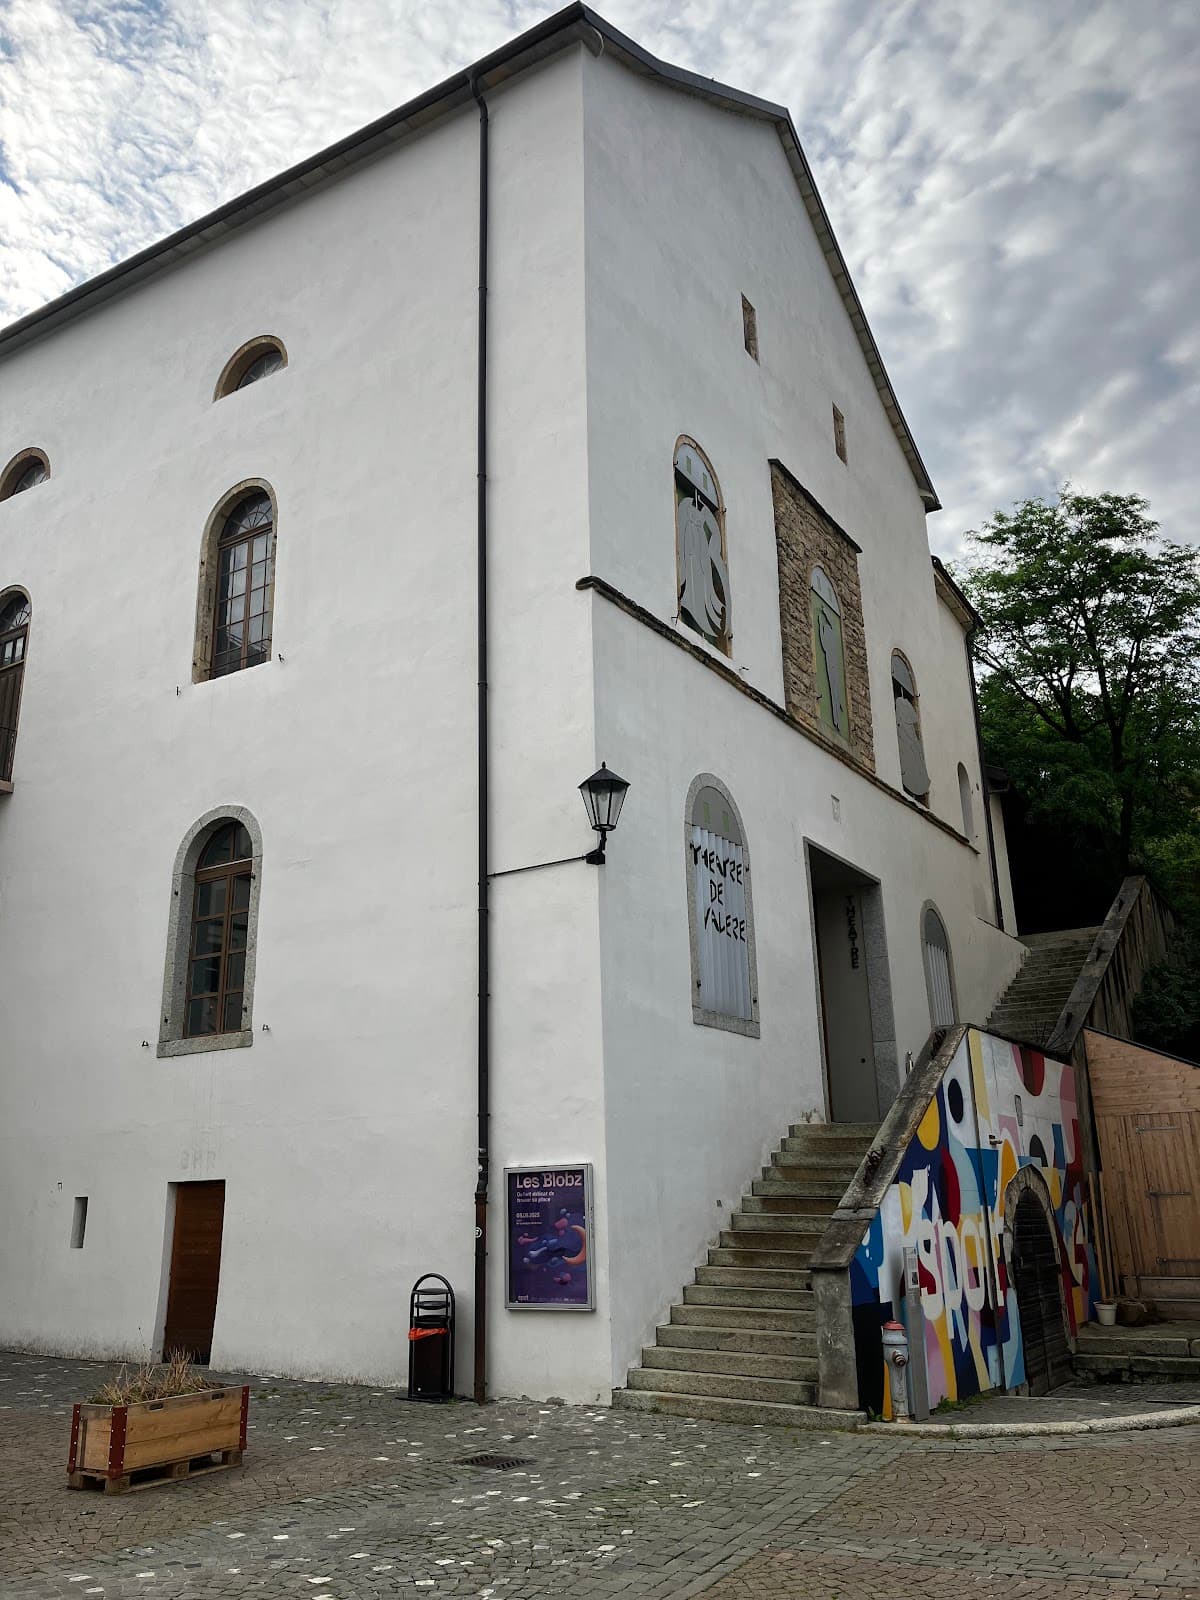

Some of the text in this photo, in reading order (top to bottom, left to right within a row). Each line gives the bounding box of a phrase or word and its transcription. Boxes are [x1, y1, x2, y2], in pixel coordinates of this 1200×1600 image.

[709, 878, 723, 905] DE
[704, 906, 746, 942] VALERE
[845, 895, 859, 969] THEATRE
[516, 1172, 582, 1189] Les Blobz
